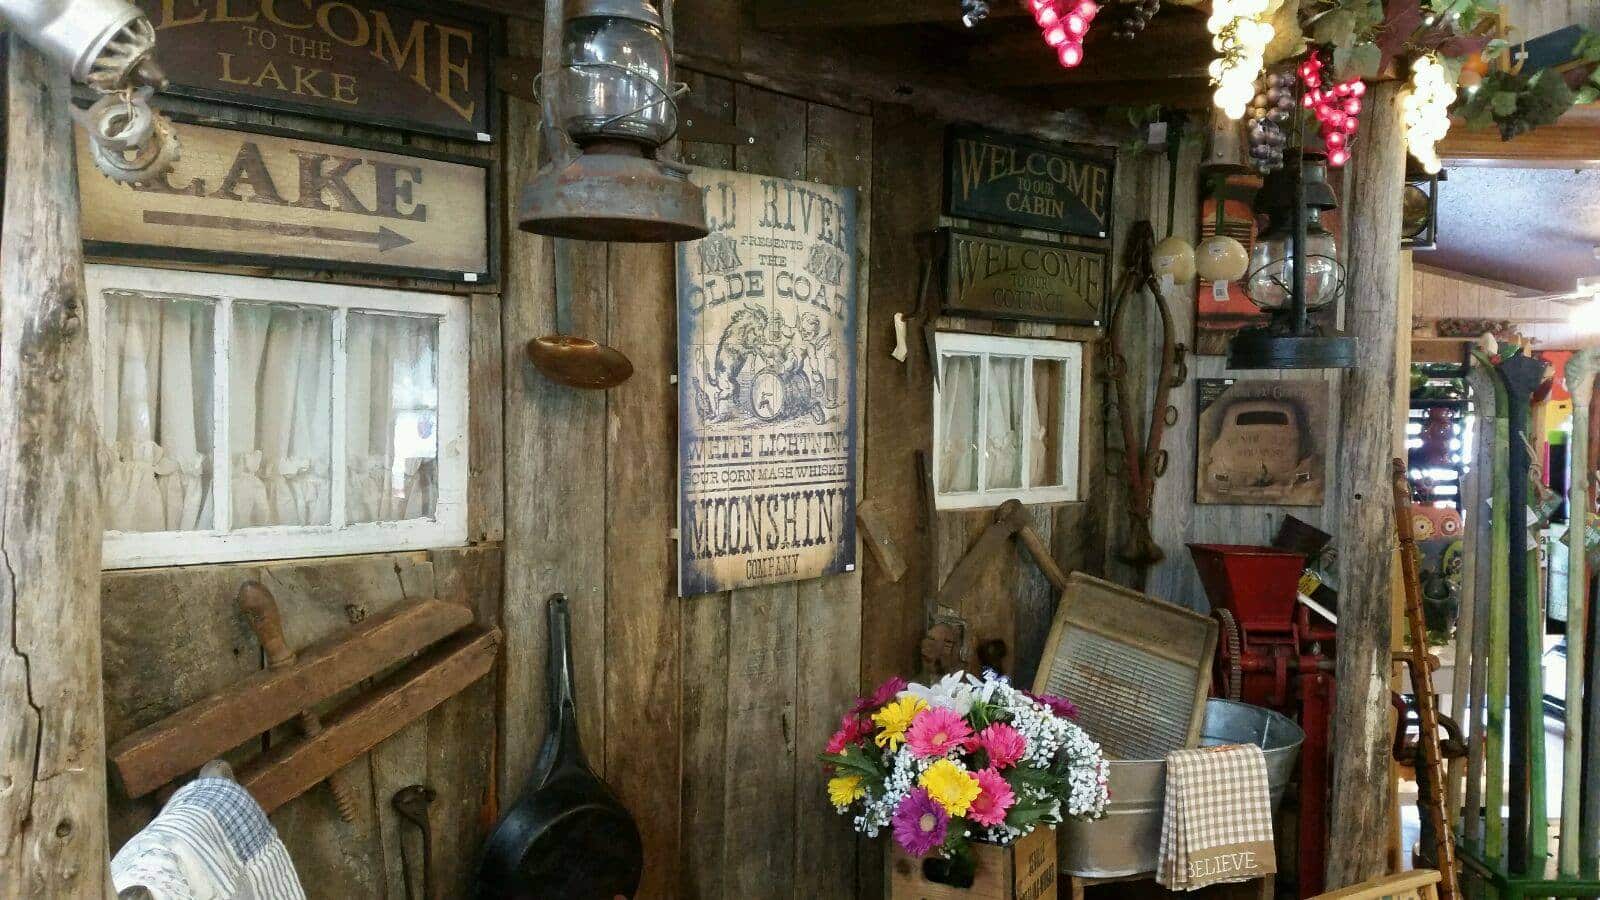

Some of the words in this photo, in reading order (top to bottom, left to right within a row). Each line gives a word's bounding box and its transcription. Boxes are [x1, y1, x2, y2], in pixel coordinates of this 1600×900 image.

[242, 25, 277, 50] TO
[284, 34, 334, 62] THE
[154, 0, 474, 123] ELCOME
[216, 52, 360, 105] LAKE
[957, 138, 1108, 225] WELCOME
[759, 179, 846, 251] RIVER
[1006, 191, 1065, 219] CABIN
[740, 235, 804, 251] PRESENTS
[758, 253, 788, 268] THE
[958, 239, 1103, 313] WELCOME
[687, 270, 766, 316] OLDE
[776, 270, 848, 320] GOAT
[686, 434, 753, 460] WHITE
[721, 468, 756, 484] CORN
[758, 465, 793, 481] MASH
[746, 553, 800, 580] COMPANY
[1188, 851, 1258, 878] BELIEVE
